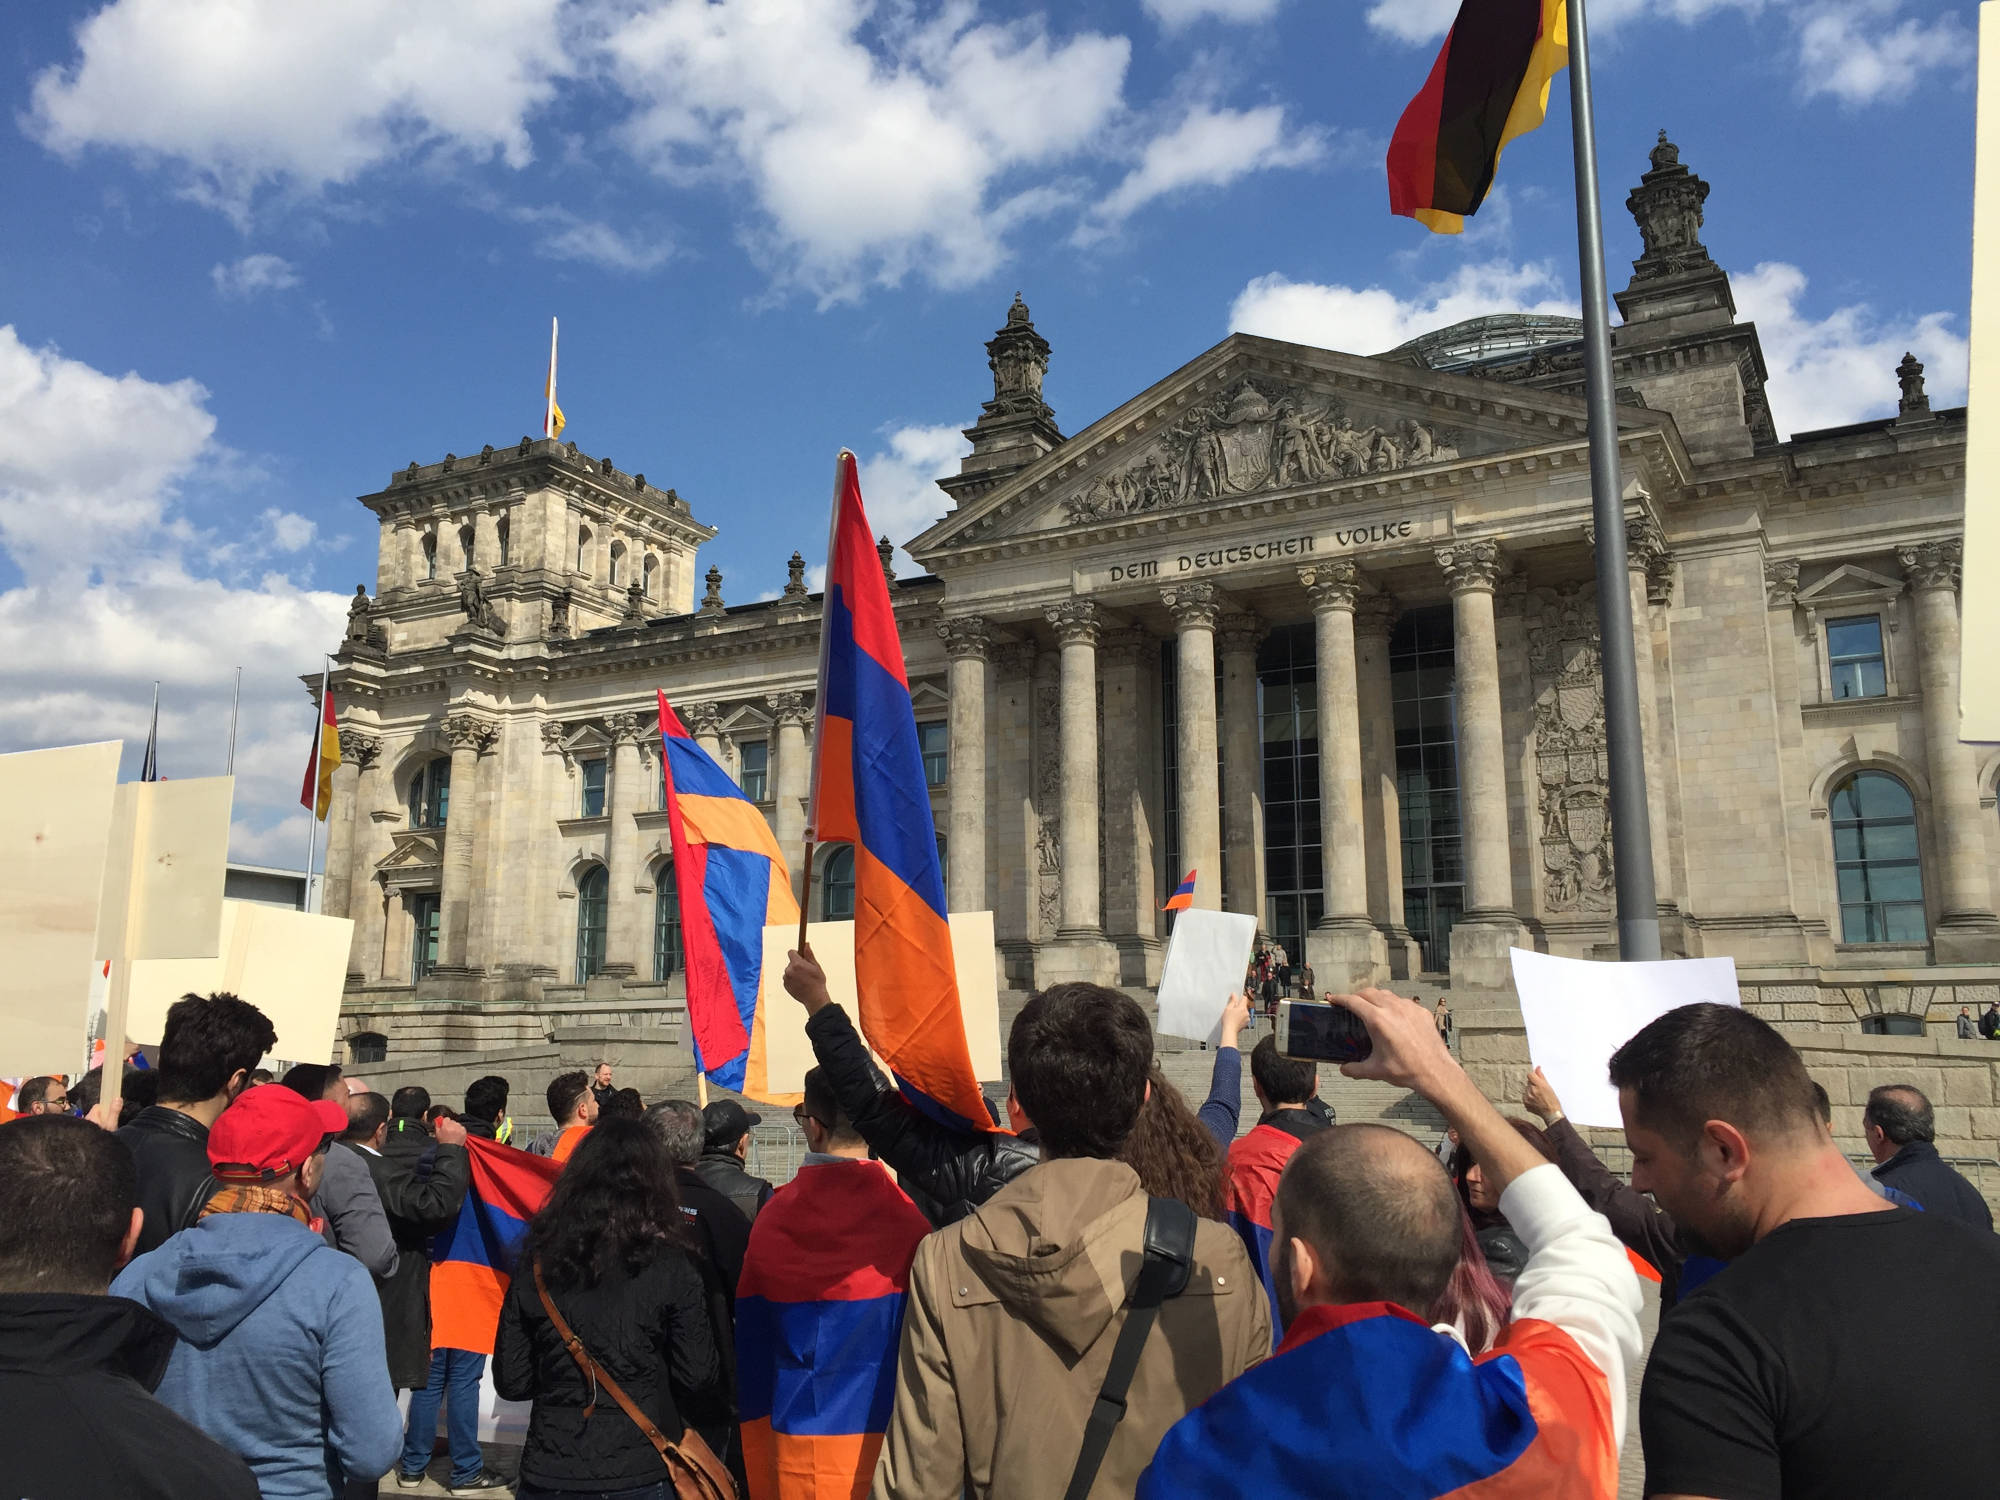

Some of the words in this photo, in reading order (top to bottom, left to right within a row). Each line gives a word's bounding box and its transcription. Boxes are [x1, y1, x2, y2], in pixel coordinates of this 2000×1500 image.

[1109, 560, 1158, 582] DEM
[1177, 536, 1314, 572] DEUTSCHEN
[1335, 520, 1412, 547] VOLKE
